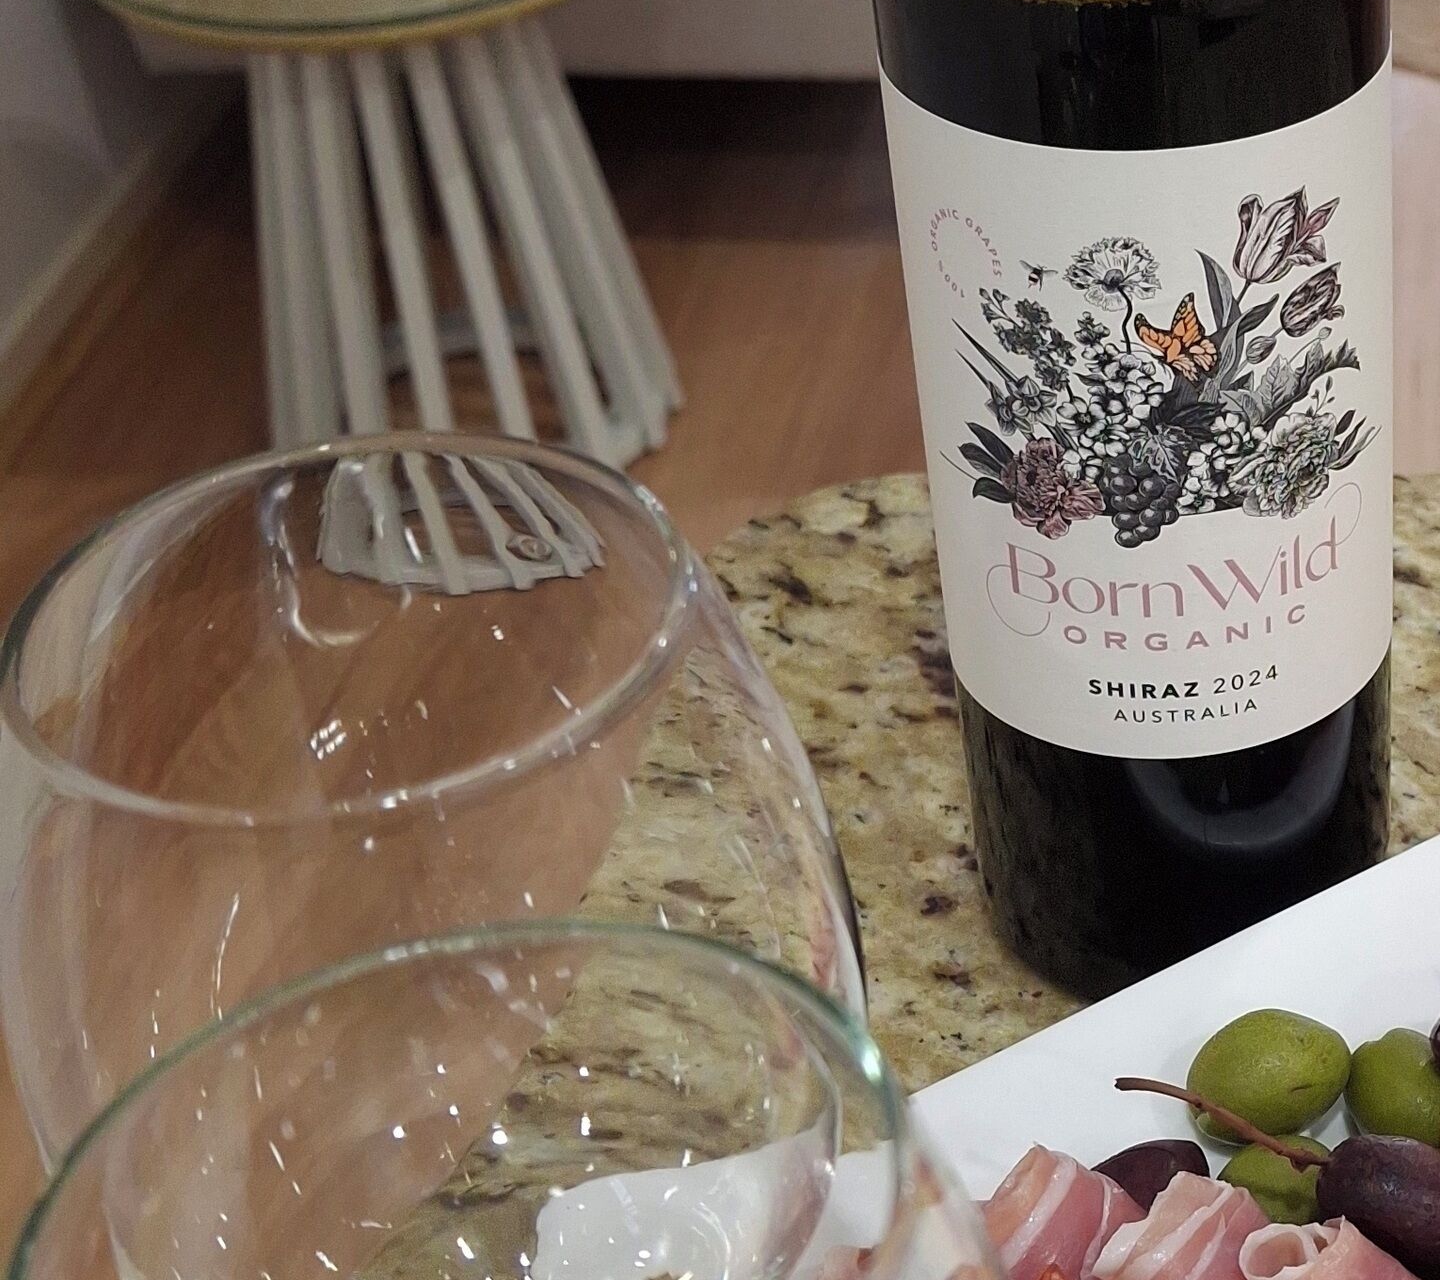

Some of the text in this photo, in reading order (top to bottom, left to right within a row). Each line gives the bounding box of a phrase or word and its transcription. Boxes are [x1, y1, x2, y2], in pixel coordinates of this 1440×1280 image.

[929, 207, 960, 252] ORGANIC
[965, 217, 1002, 278] GRAPES
[986, 482, 1362, 637] Born Wild
[1063, 604, 1306, 651] ORGANIC
[1088, 664, 1279, 700] SHIRAZ 2024
[1113, 698, 1258, 724] AUSTRALIA
